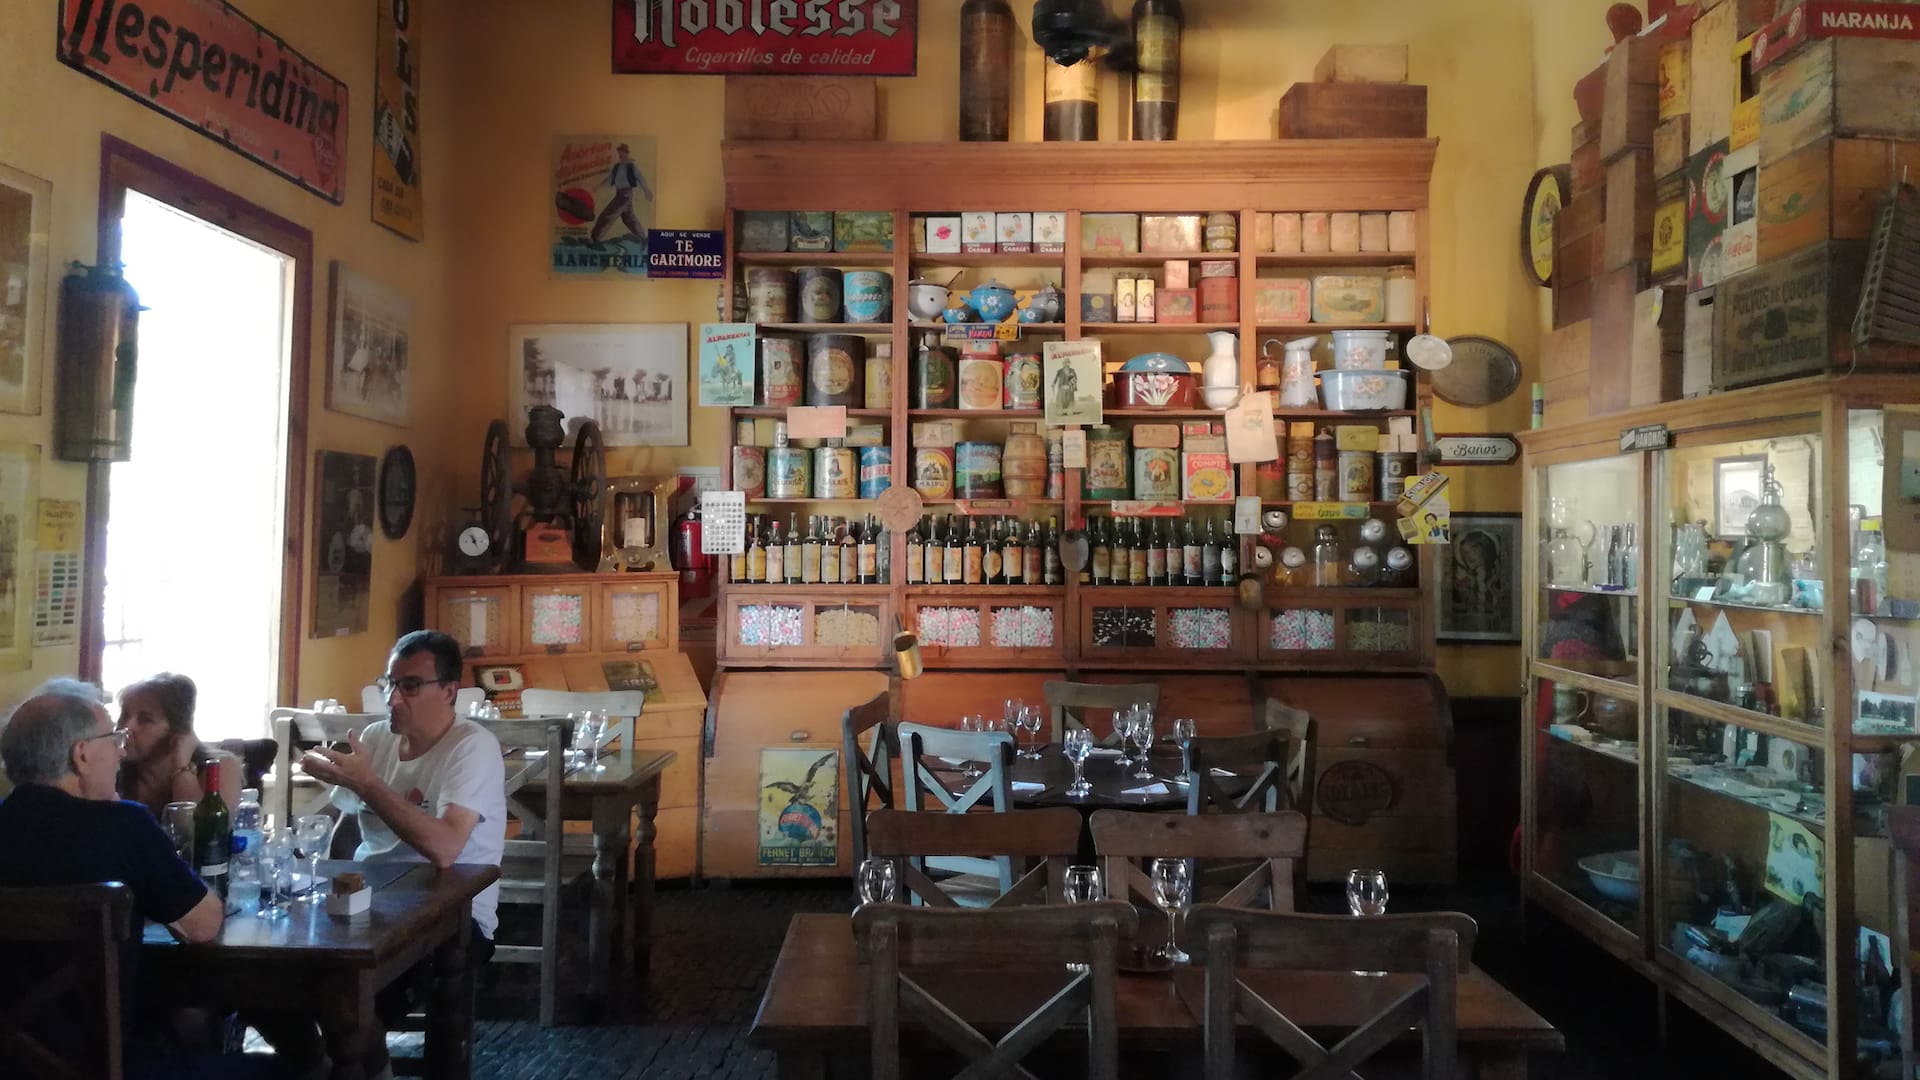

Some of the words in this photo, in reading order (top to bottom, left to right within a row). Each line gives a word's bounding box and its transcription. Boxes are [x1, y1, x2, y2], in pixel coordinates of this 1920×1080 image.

[1822, 10, 1914, 31] NARANJA
[685, 47, 774, 70] Cigarrillos
[780, 48, 801, 66] de
[808, 48, 876, 66] calidad
[692, 231, 711, 239] VENDE
[675, 240, 695, 253] TE
[650, 253, 723, 268] GARTMORE
[1405, 471, 1440, 500] SUNLIGHT
[762, 847, 794, 858] FERNET
